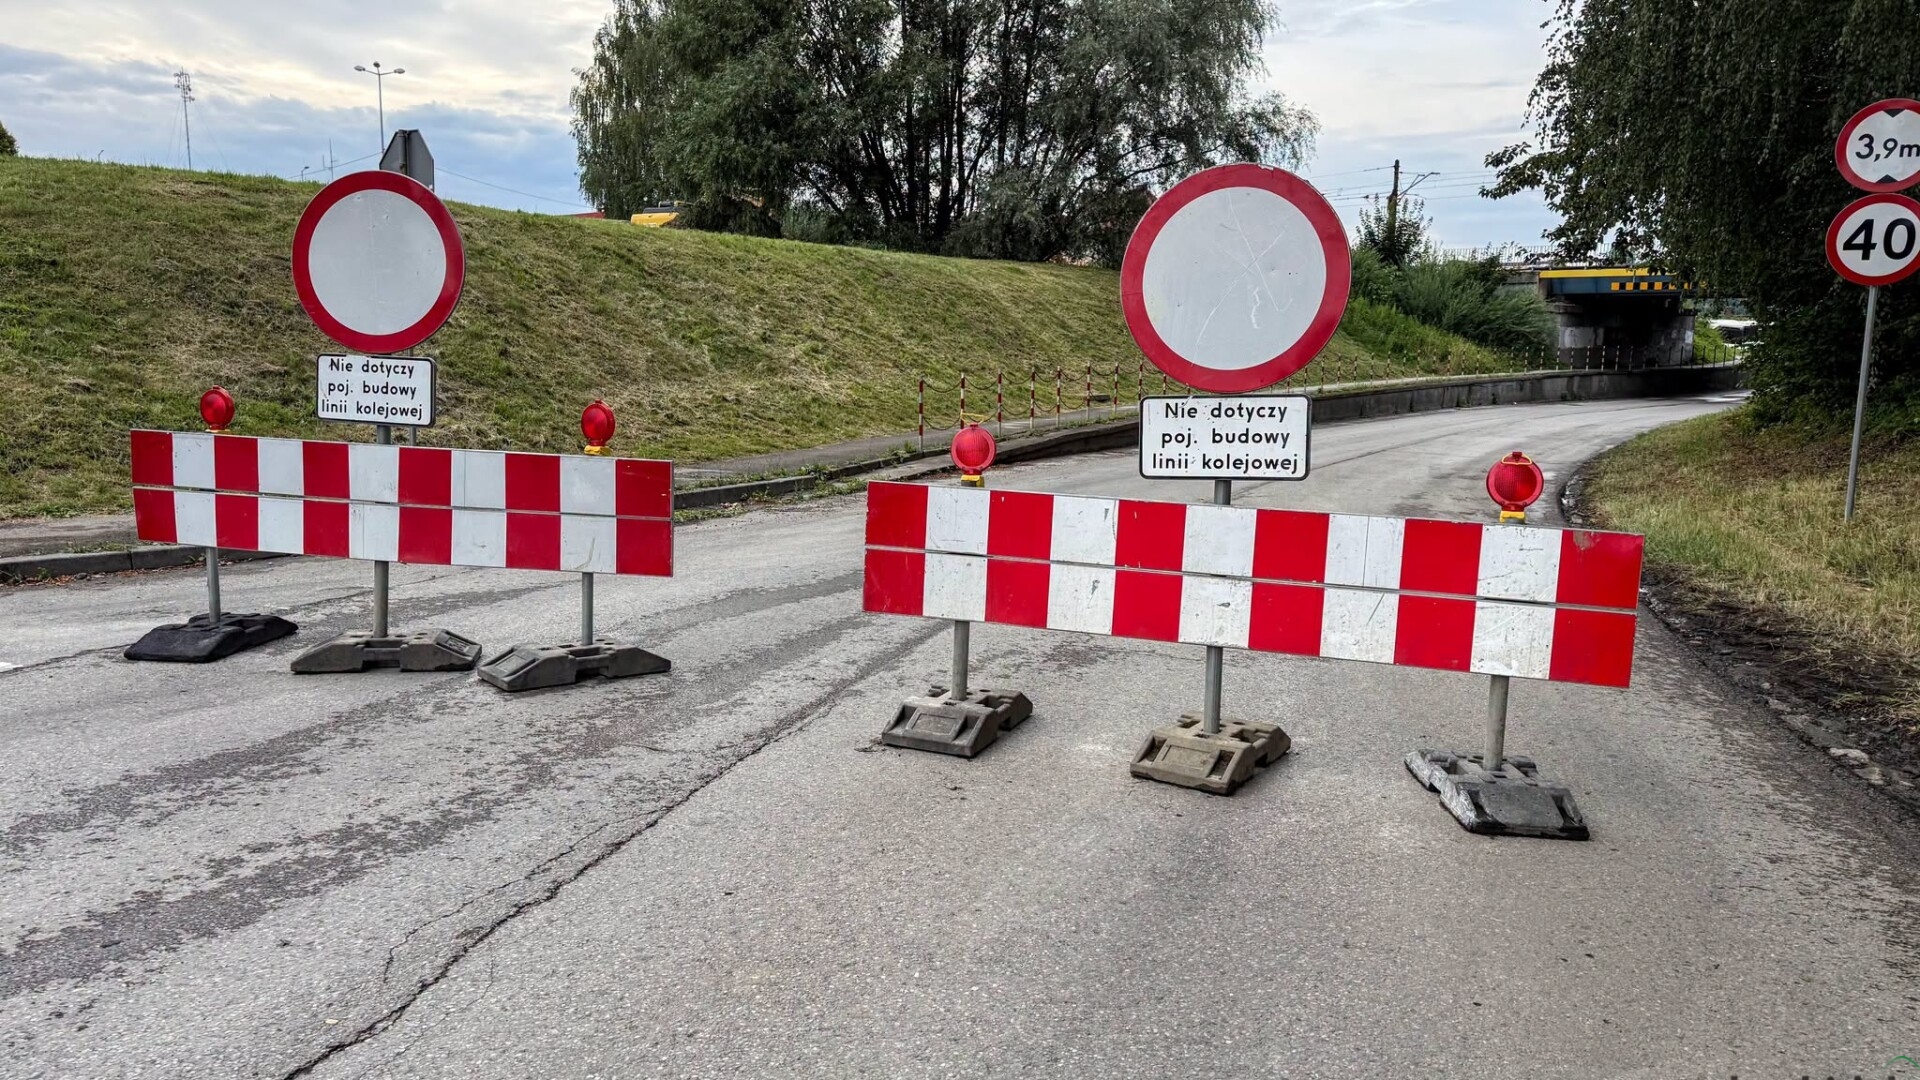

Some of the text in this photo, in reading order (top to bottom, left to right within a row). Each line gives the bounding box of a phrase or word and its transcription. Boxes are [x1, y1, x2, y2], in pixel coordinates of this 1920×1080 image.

[1855, 133, 1920, 162] 3,9m
[1842, 217, 1916, 261] 40
[329, 358, 415, 379] Nie dotyczy
[328, 379, 417, 400] poj. budowy
[321, 399, 423, 421] linii kolejowej
[1165, 402, 1288, 423] Nie dotyczy
[1161, 428, 1291, 449] poj. budowy
[1152, 453, 1298, 475] linii kolejowej
